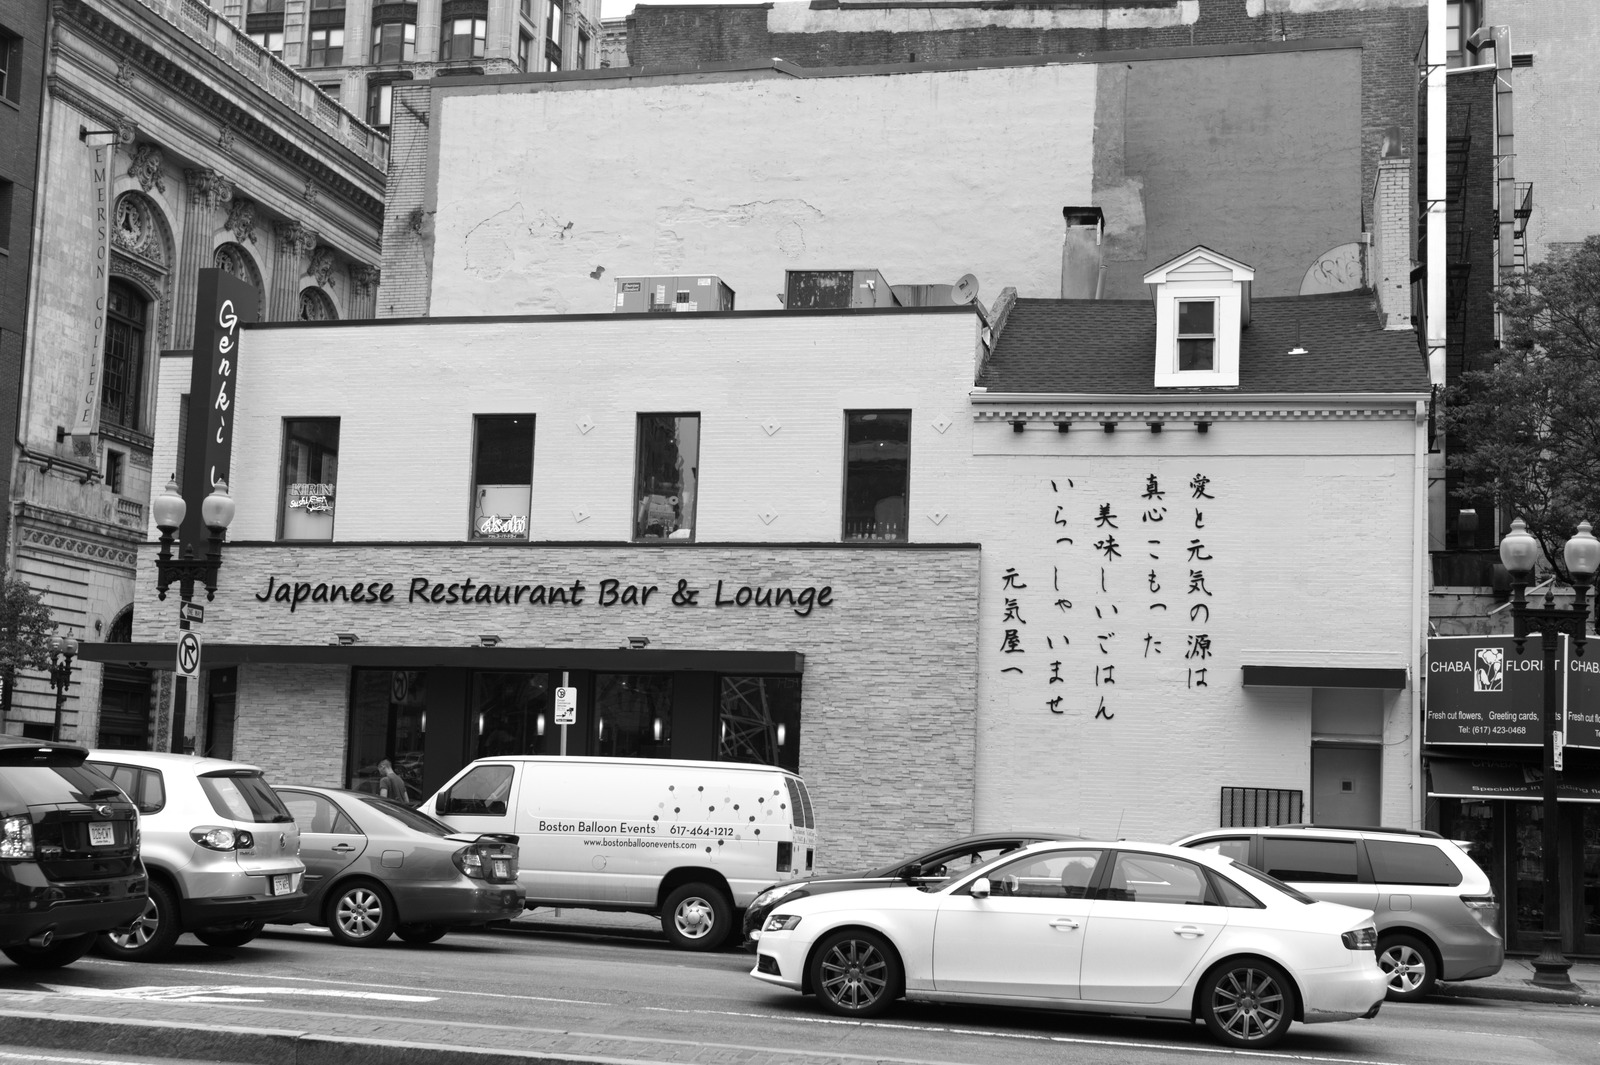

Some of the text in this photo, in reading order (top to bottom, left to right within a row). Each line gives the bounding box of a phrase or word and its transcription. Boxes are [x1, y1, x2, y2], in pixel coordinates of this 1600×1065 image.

[82, 149, 105, 422] EMERSON COLLEGE
[215, 299, 238, 444] Genki
[291, 483, 333, 496] KIRIN
[481, 515, 526, 533] Asahi
[1141, 473, 1167, 658] 真心こもった
[1184, 472, 1215, 689] 愛と元気の源は
[255, 576, 834, 617] Japanese Restaurant Bar & Lounge
[1046, 478, 1074, 714] いらっしゃいませ
[1093, 502, 1122, 720] 美味しいごはん
[1000, 567, 1027, 674] 元気屋へ
[1430, 659, 1561, 673] CHABA FLORIT
[1570, 659, 1600, 673] CHAB
[1428, 710, 1540, 722] Fresh cut flowers, Greeting cards,
[1568, 711, 1585, 721] Fresh
[1585, 713, 1595, 722] cut
[1458, 725, 1527, 735] Tel: (617) 423-0468
[539, 820, 734, 837] Boston Balloon Events 617-464-1212
[583, 837, 697, 849] www.bostonballoonevents.com
